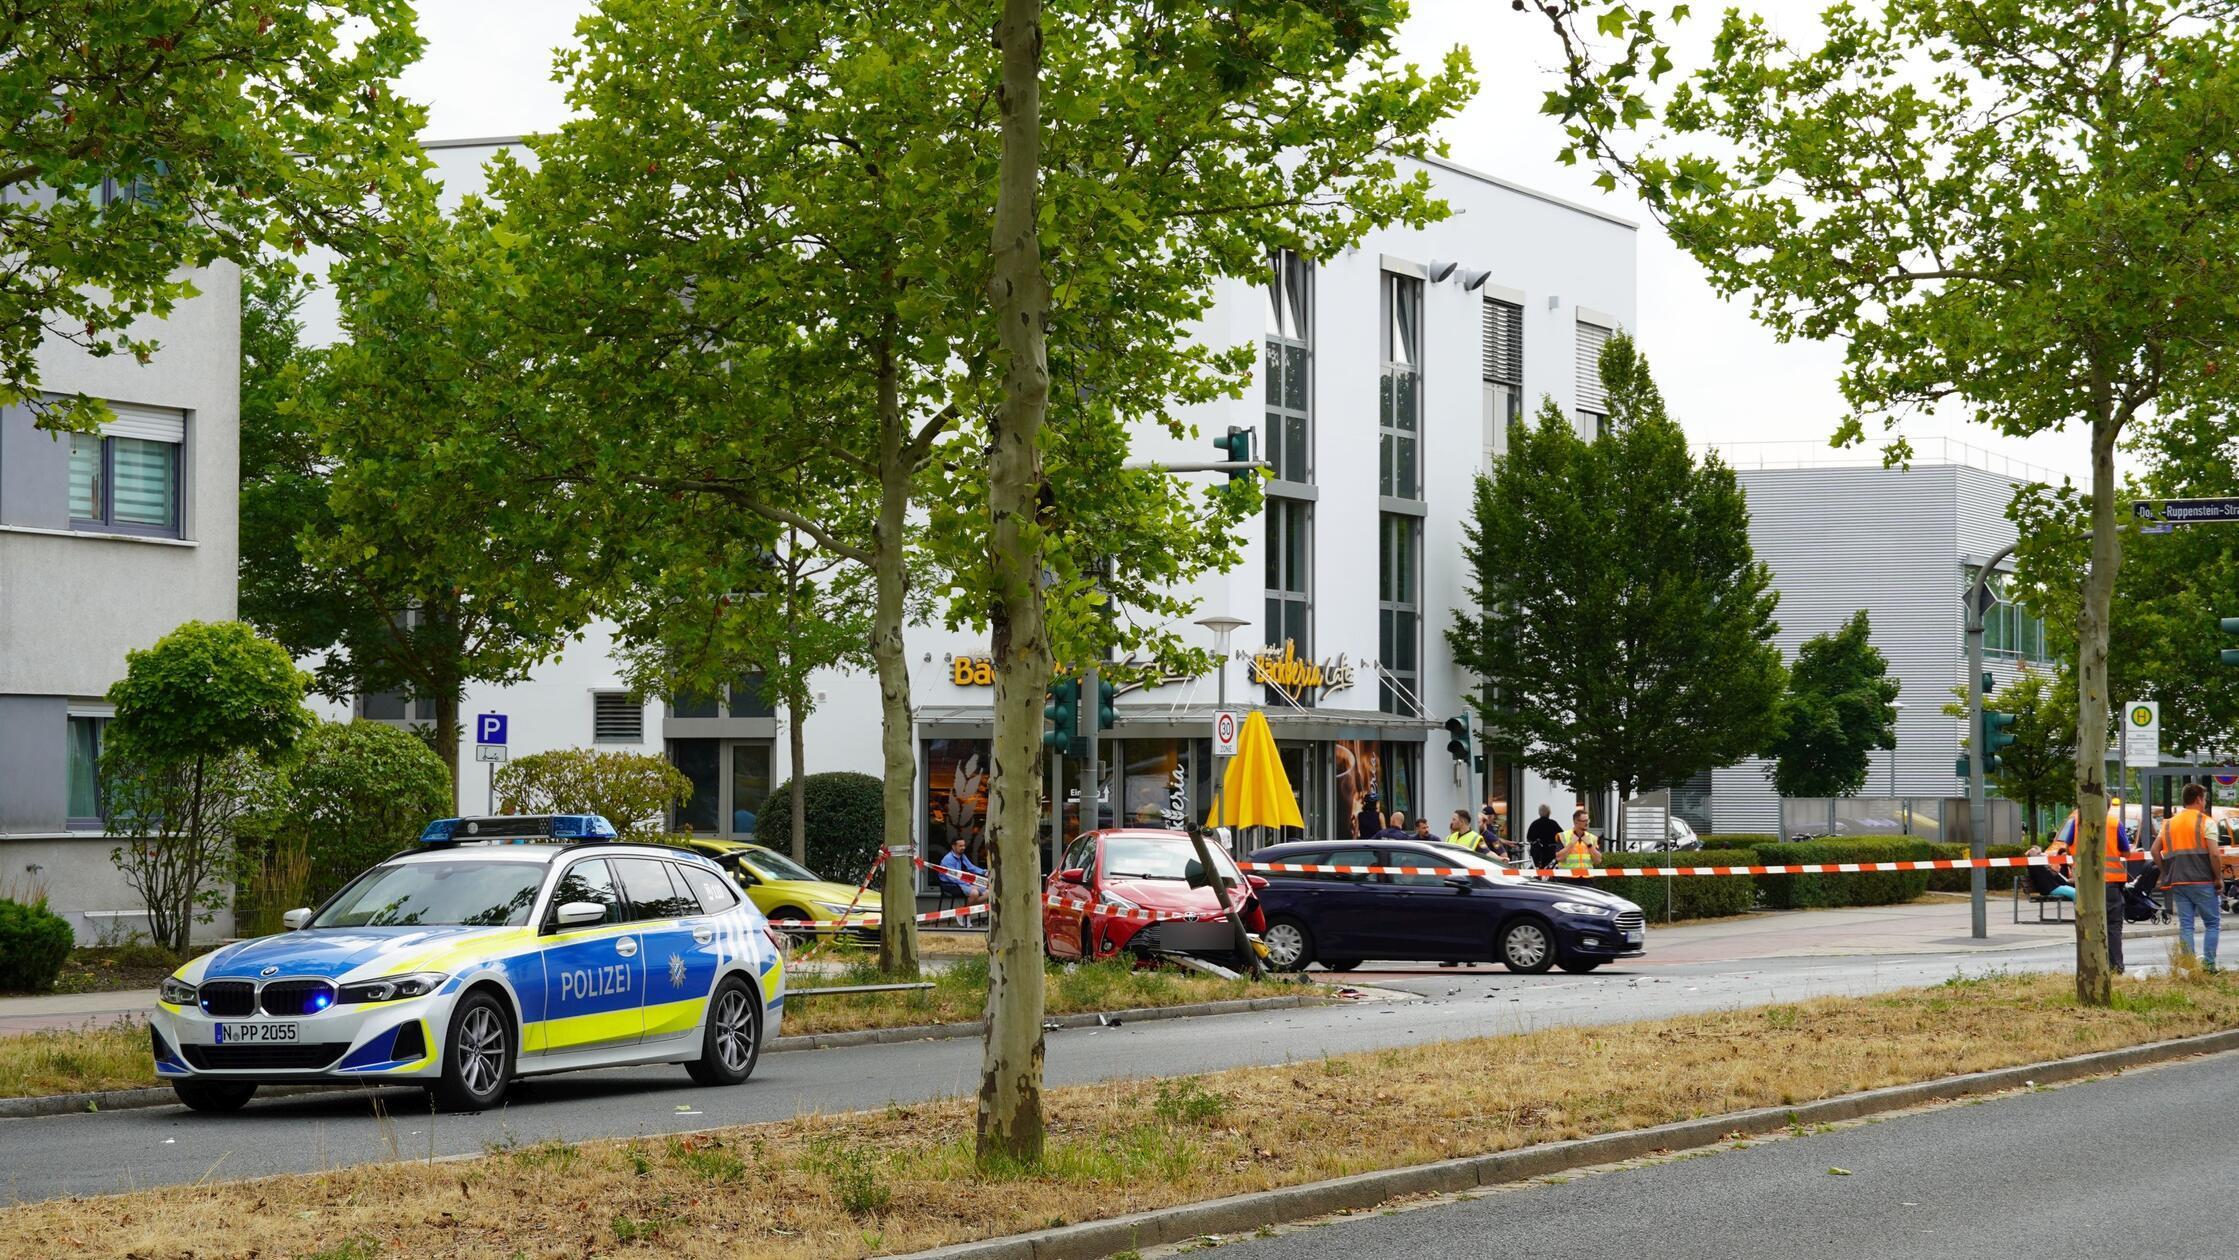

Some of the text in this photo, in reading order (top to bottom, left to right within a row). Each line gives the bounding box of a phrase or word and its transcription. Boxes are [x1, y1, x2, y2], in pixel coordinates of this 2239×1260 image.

[2137, 710, 2146, 722] H
[484, 717, 501, 740] P
[1221, 721, 1231, 736] 30
[1220, 745, 1233, 753] ZONE
[560, 963, 631, 1001] POLIZEI
[223, 1024, 296, 1041] N PP 2055
